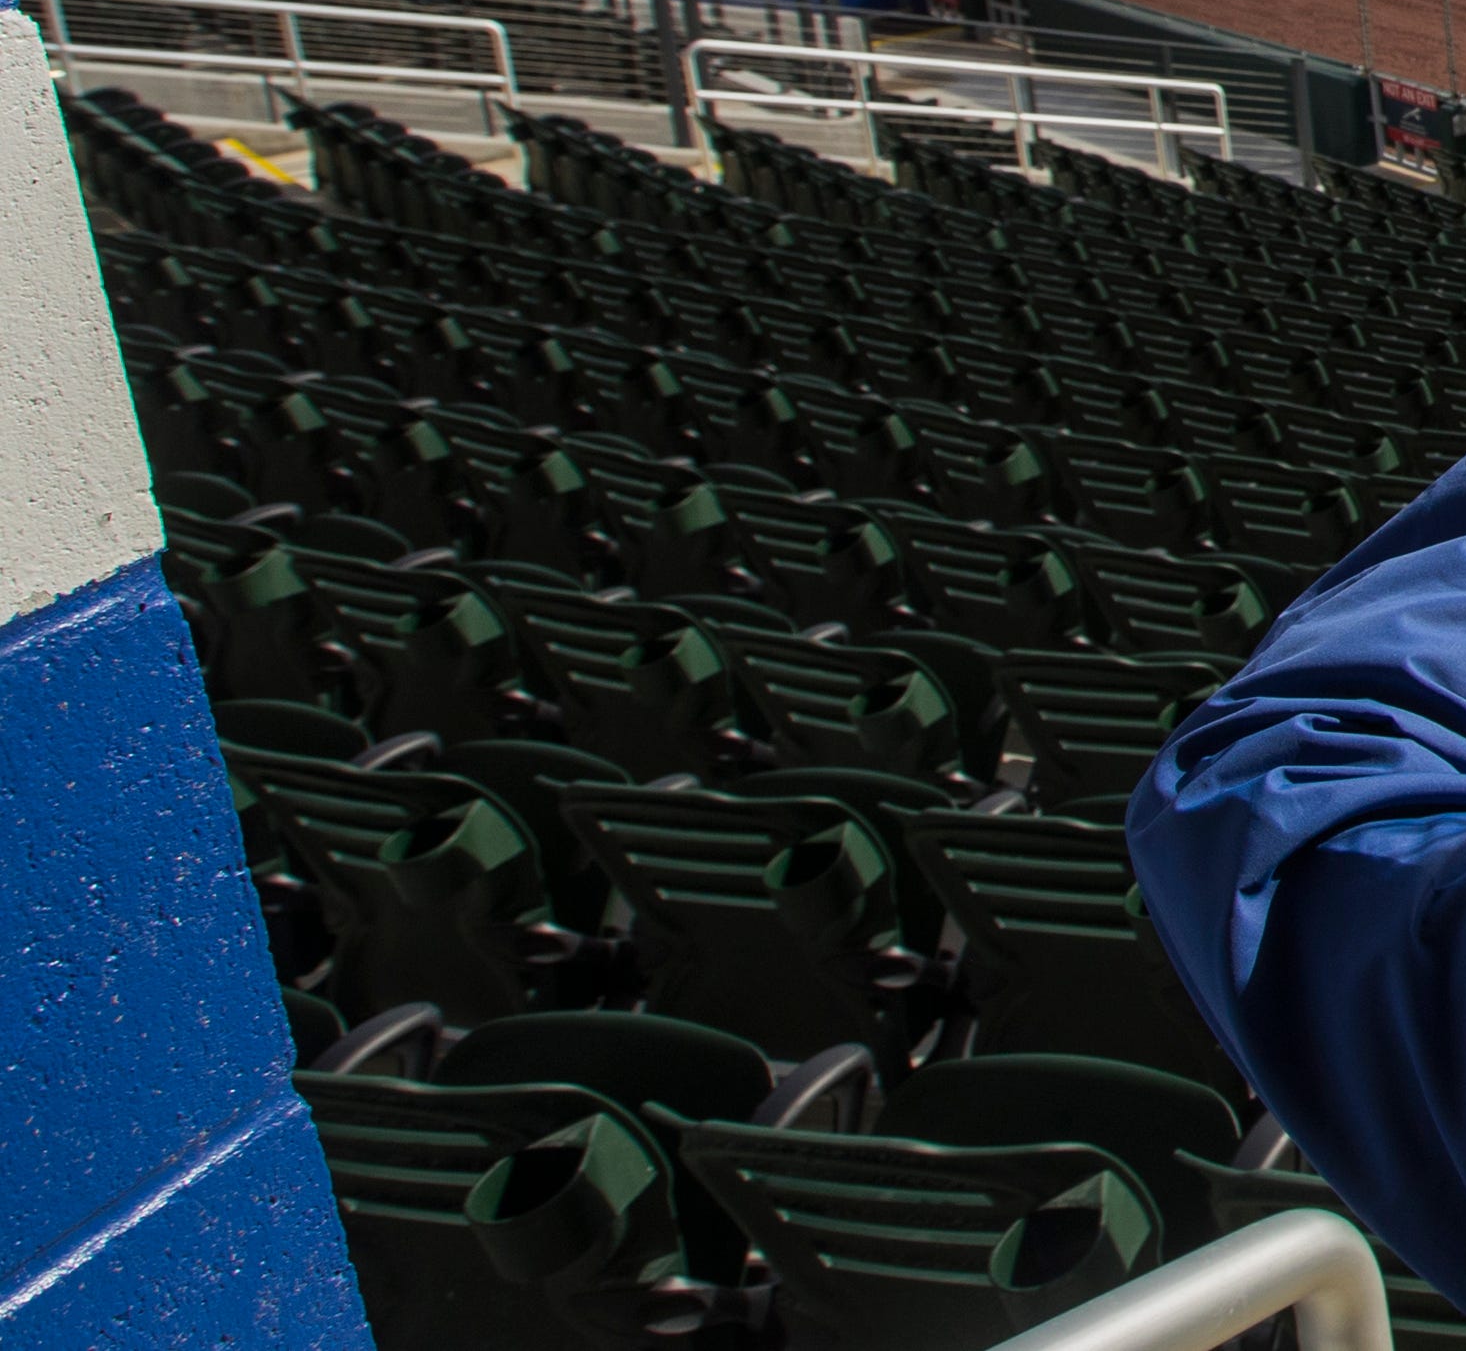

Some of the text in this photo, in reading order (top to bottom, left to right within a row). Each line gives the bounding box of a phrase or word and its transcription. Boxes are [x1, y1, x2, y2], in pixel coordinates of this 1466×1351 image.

[1382, 81, 1438, 109] NOT AN EXIT
